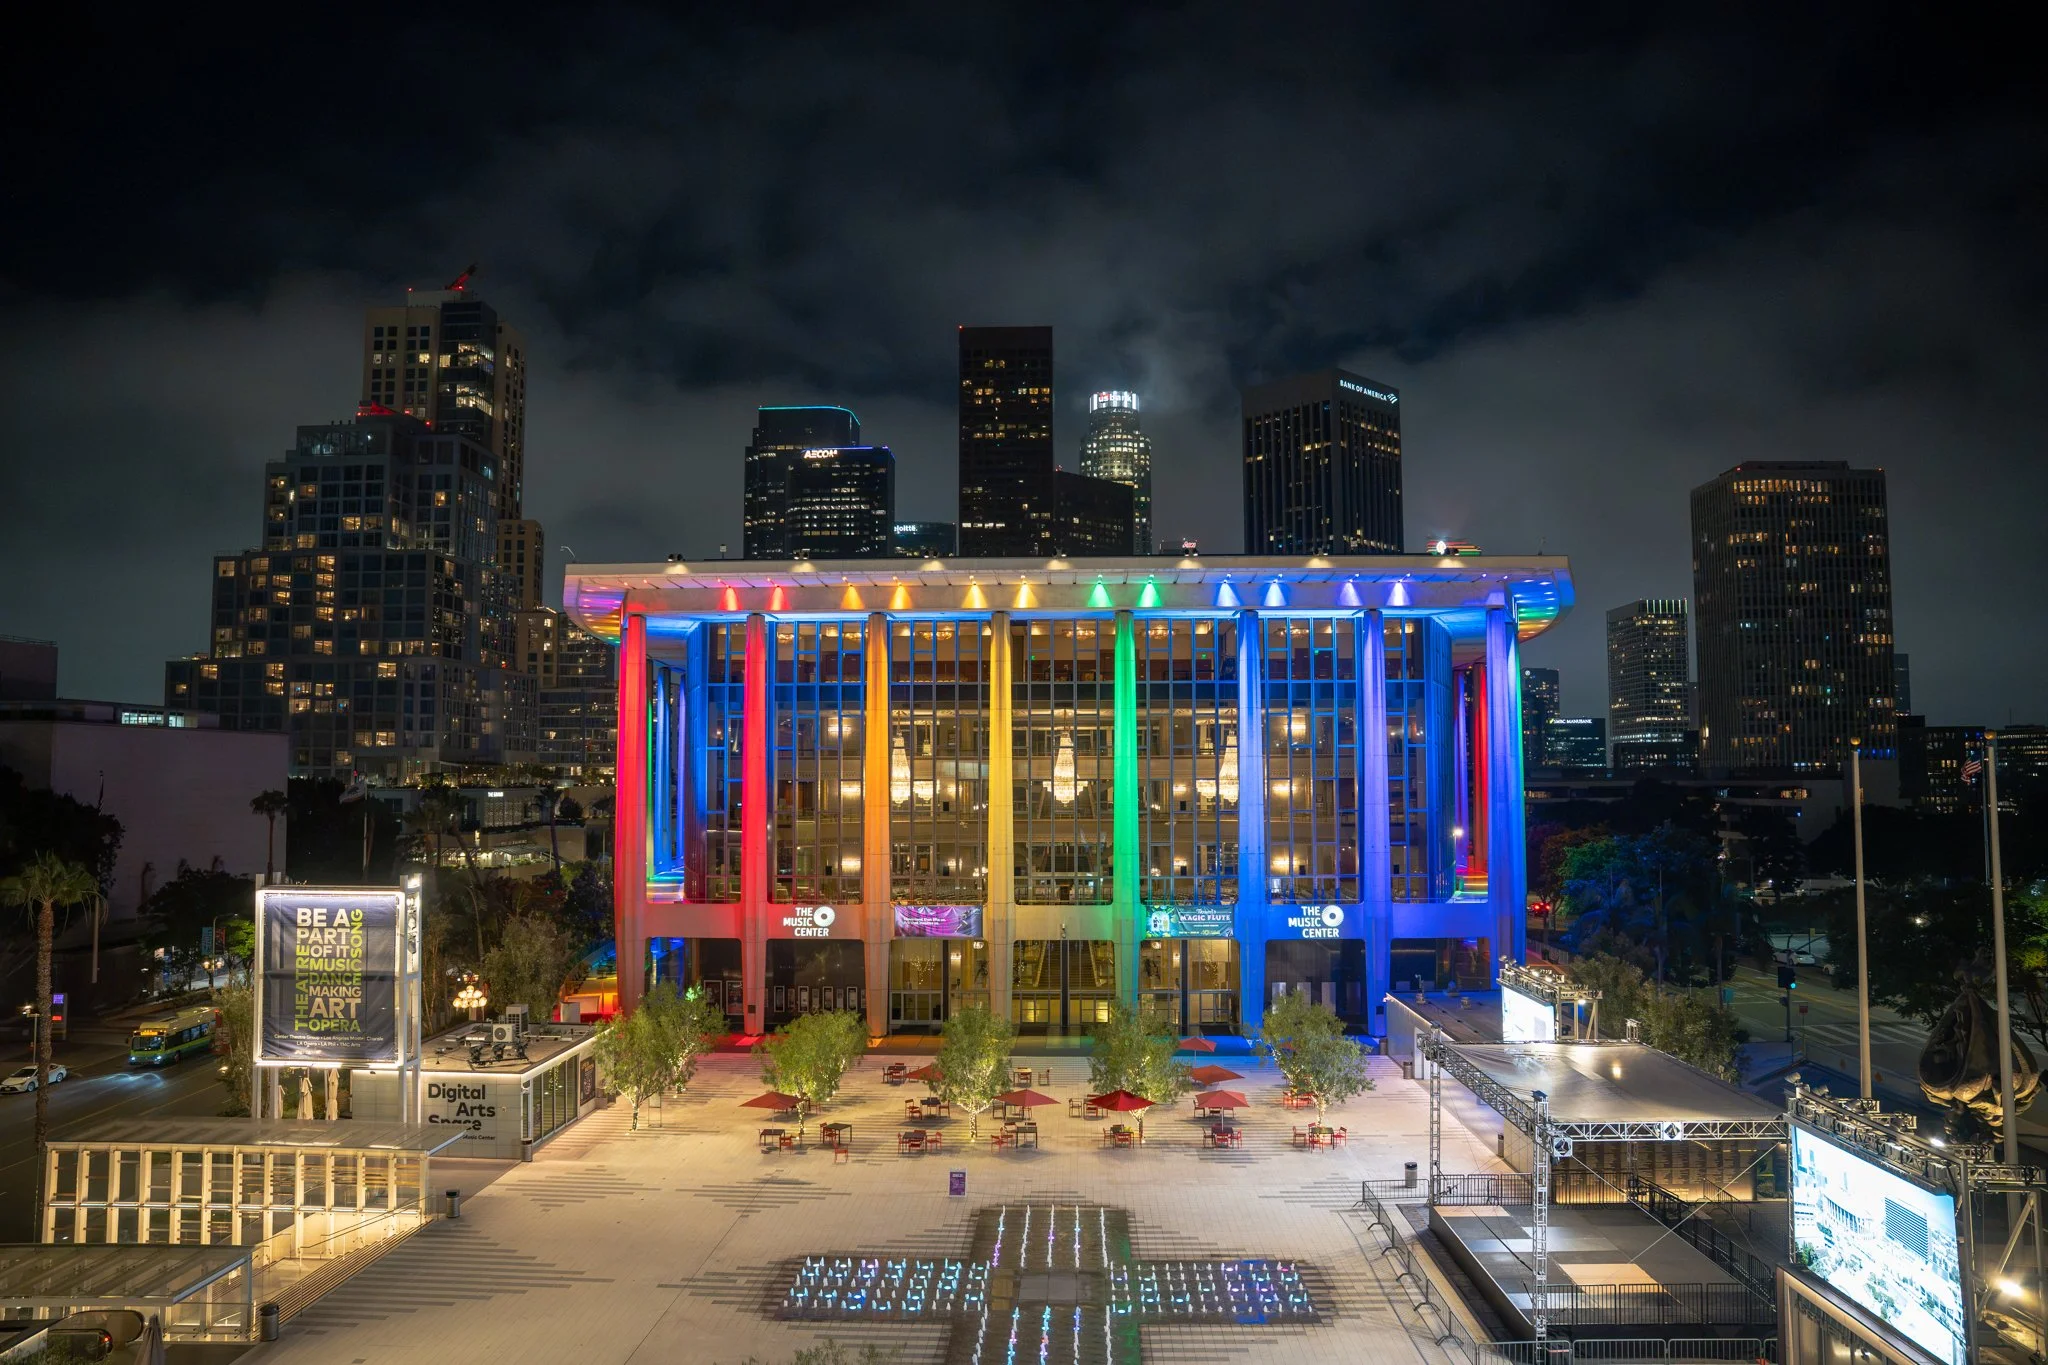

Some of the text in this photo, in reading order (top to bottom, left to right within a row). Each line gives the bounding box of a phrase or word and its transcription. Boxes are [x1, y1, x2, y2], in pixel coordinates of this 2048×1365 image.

[340, 379, 388, 402] BANK OF AMERICA
[296, 908, 350, 927] BE A
[795, 907, 813, 917] THE
[1301, 906, 1320, 917] THE
[783, 917, 813, 927] MUSIC
[1288, 917, 1321, 928] MUSIC
[296, 928, 350, 945] PART
[351, 908, 363, 958] SONG
[794, 927, 830, 937] CENTER
[1302, 928, 1339, 938] CENTER
[310, 945, 350, 958] OF IT
[310, 958, 362, 972] MUSIC
[310, 972, 362, 985] DANCE
[295, 944, 310, 1031] THEATRE
[308, 986, 362, 997] MAKING
[310, 998, 362, 1018] ART
[308, 1019, 361, 1032] OPERA
[428, 1083, 486, 1103] Digital
[456, 1102, 496, 1117] Arts
